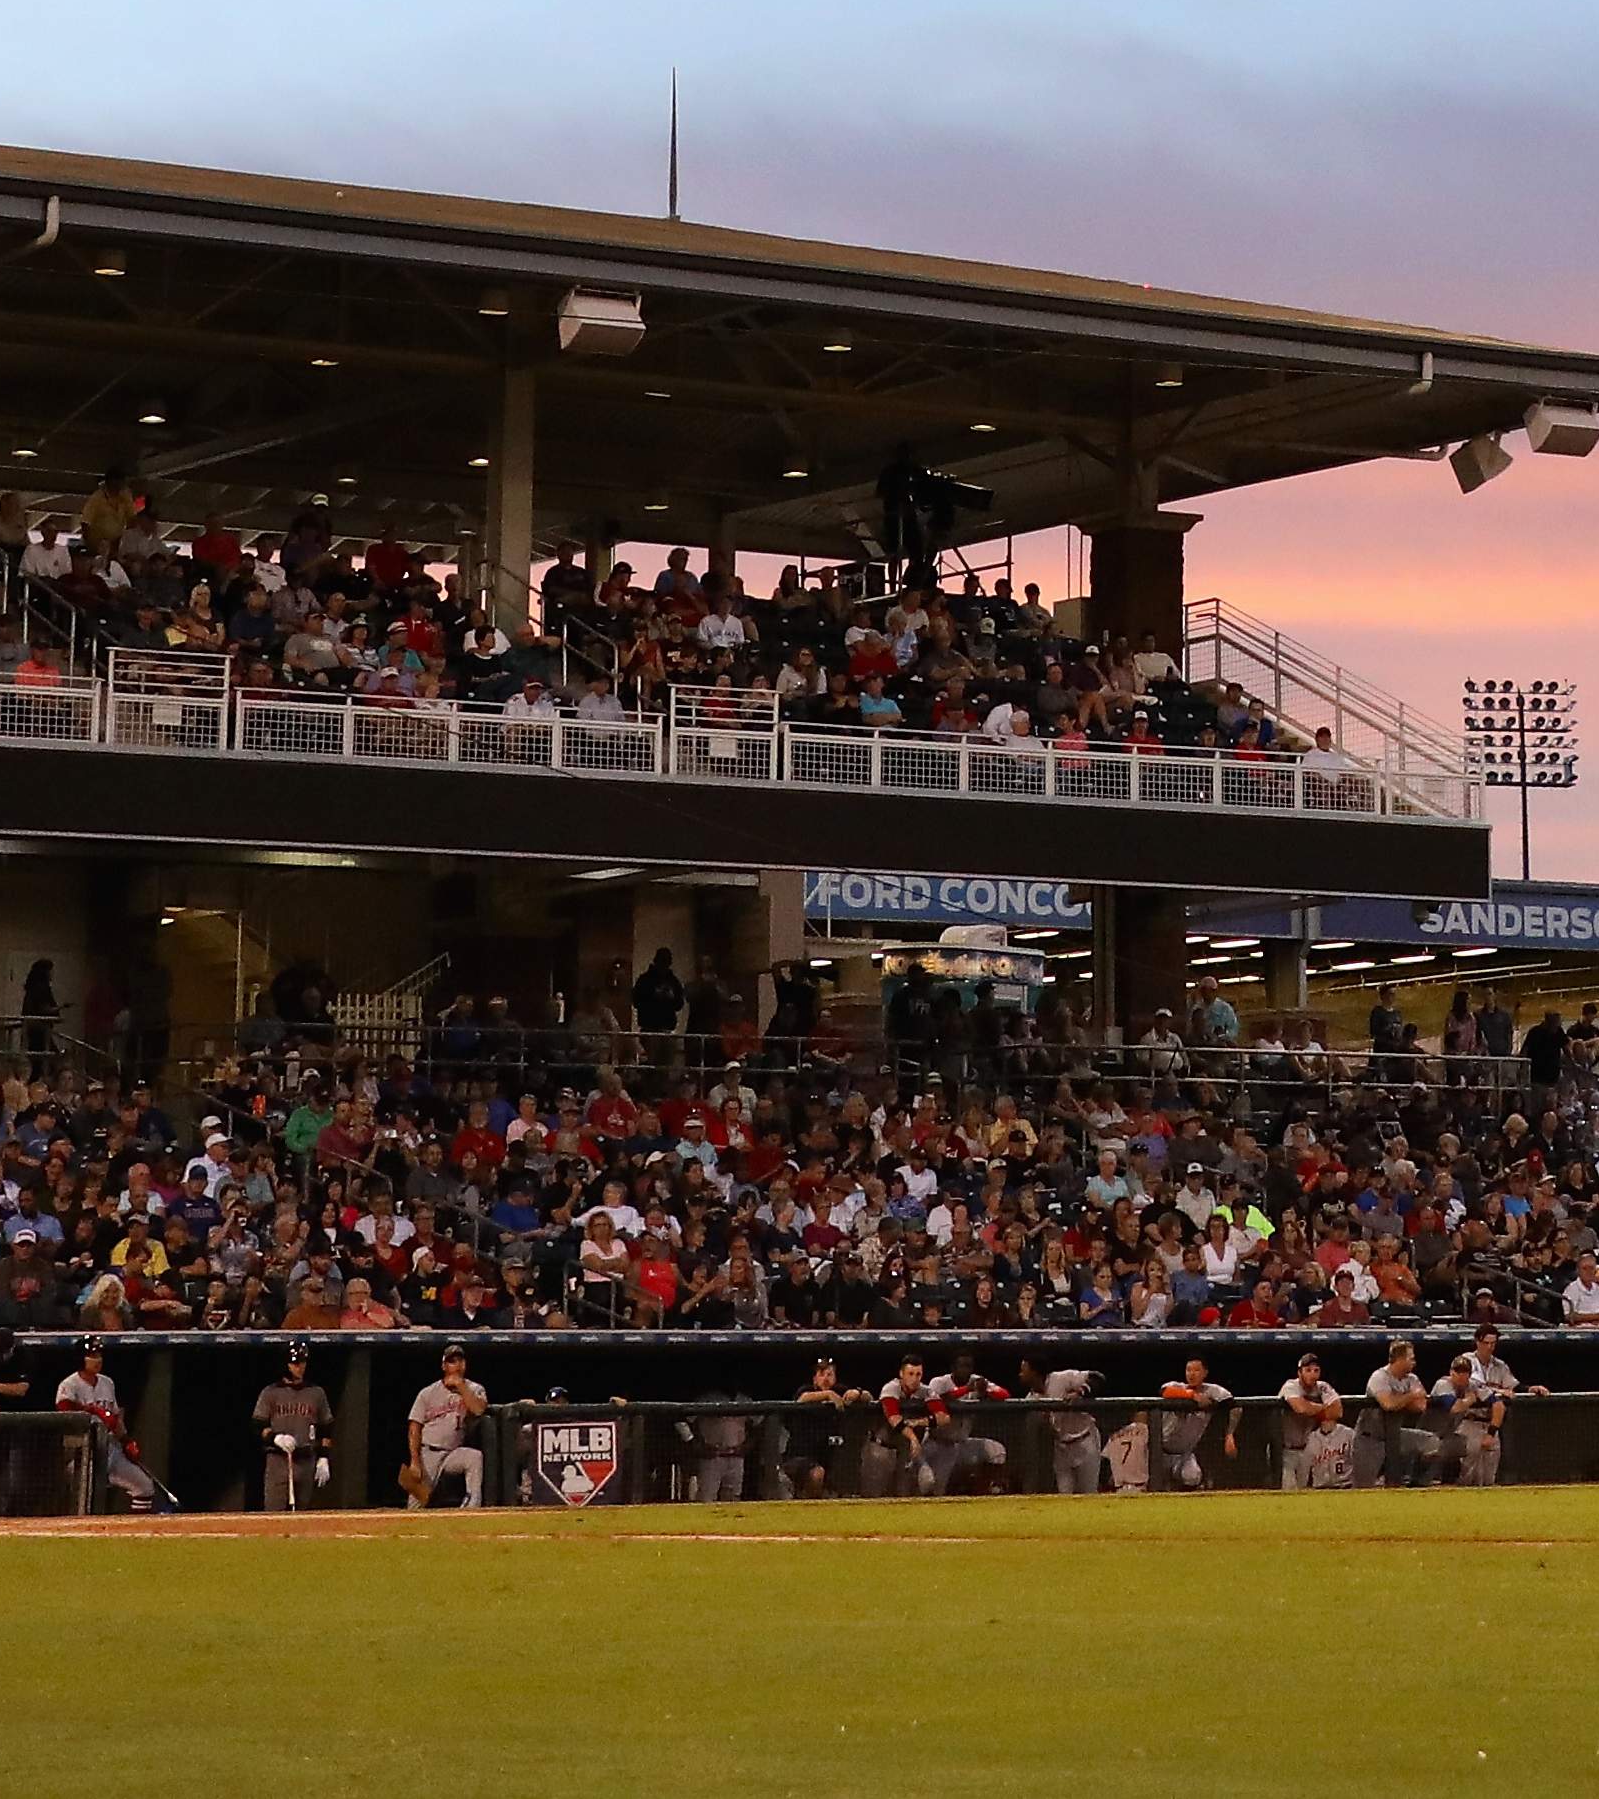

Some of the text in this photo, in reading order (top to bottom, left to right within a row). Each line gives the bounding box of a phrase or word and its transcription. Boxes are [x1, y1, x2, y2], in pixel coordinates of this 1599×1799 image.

[817, 873, 1092, 917] FORD CONCO
[543, 1427, 612, 1453] MLB
[543, 1452, 612, 1463] NETWORK
[1120, 1441, 1132, 1465] 7
